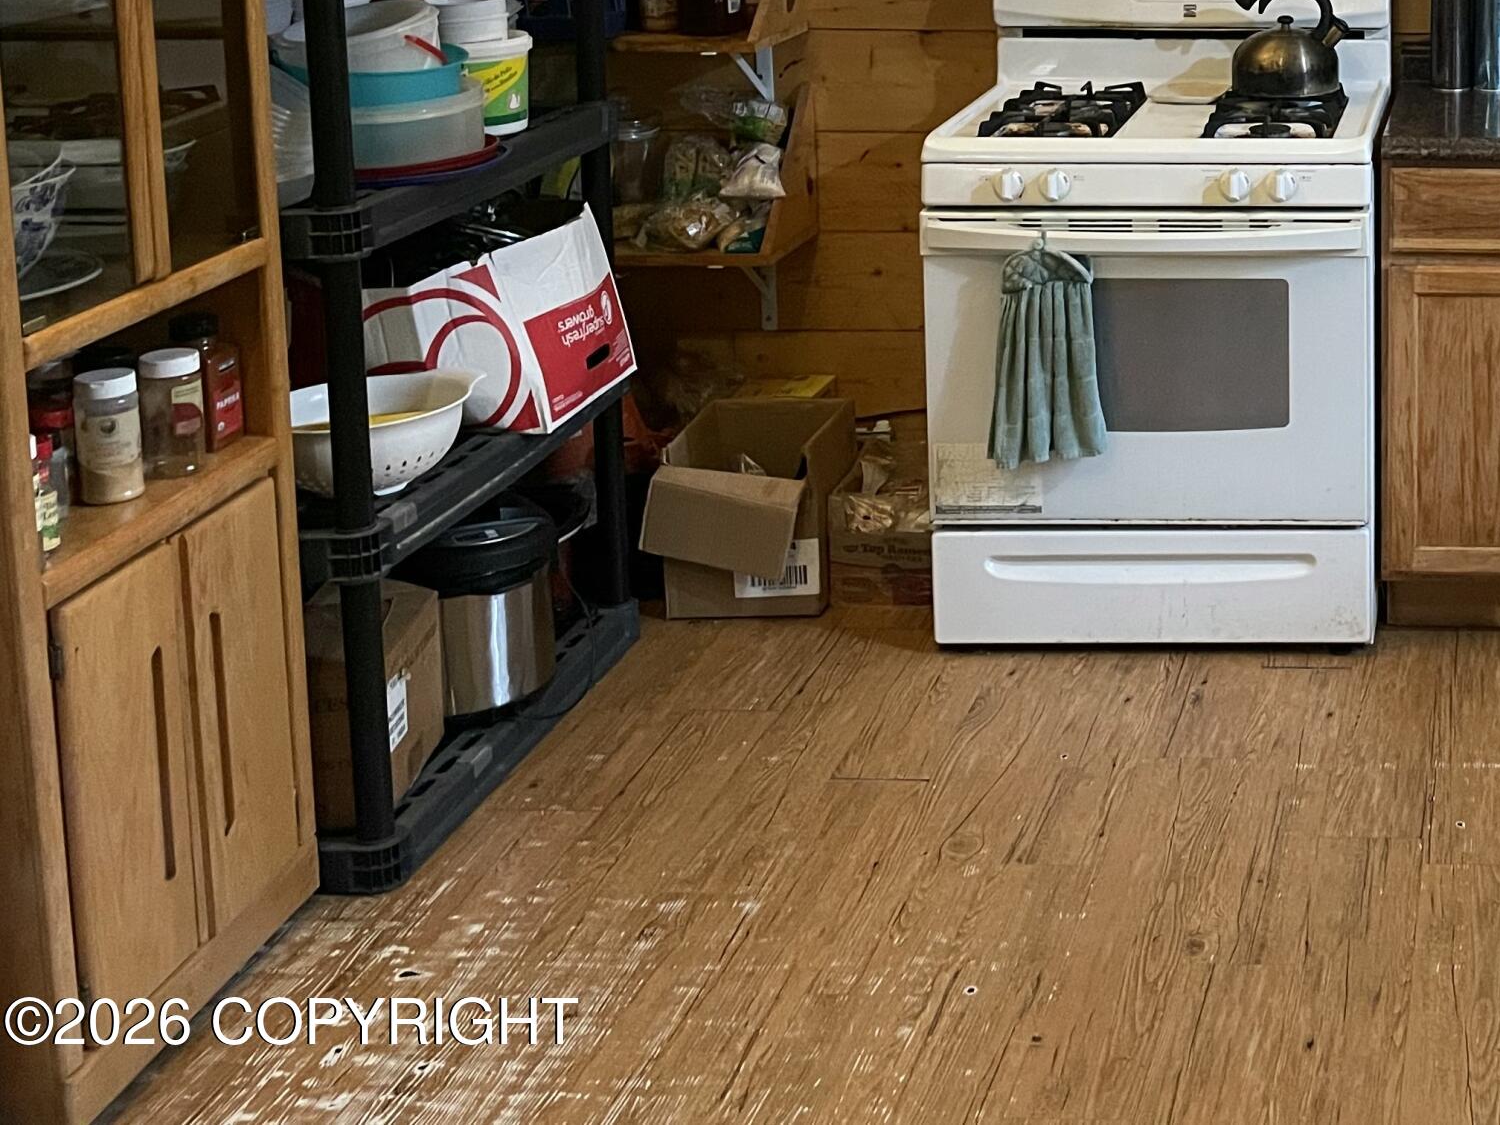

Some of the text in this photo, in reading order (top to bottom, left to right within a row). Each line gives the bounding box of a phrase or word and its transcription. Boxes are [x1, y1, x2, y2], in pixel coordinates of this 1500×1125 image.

[558, 304, 595, 332] growers
[562, 315, 605, 347] superfresh
[861, 543, 885, 555] Top
